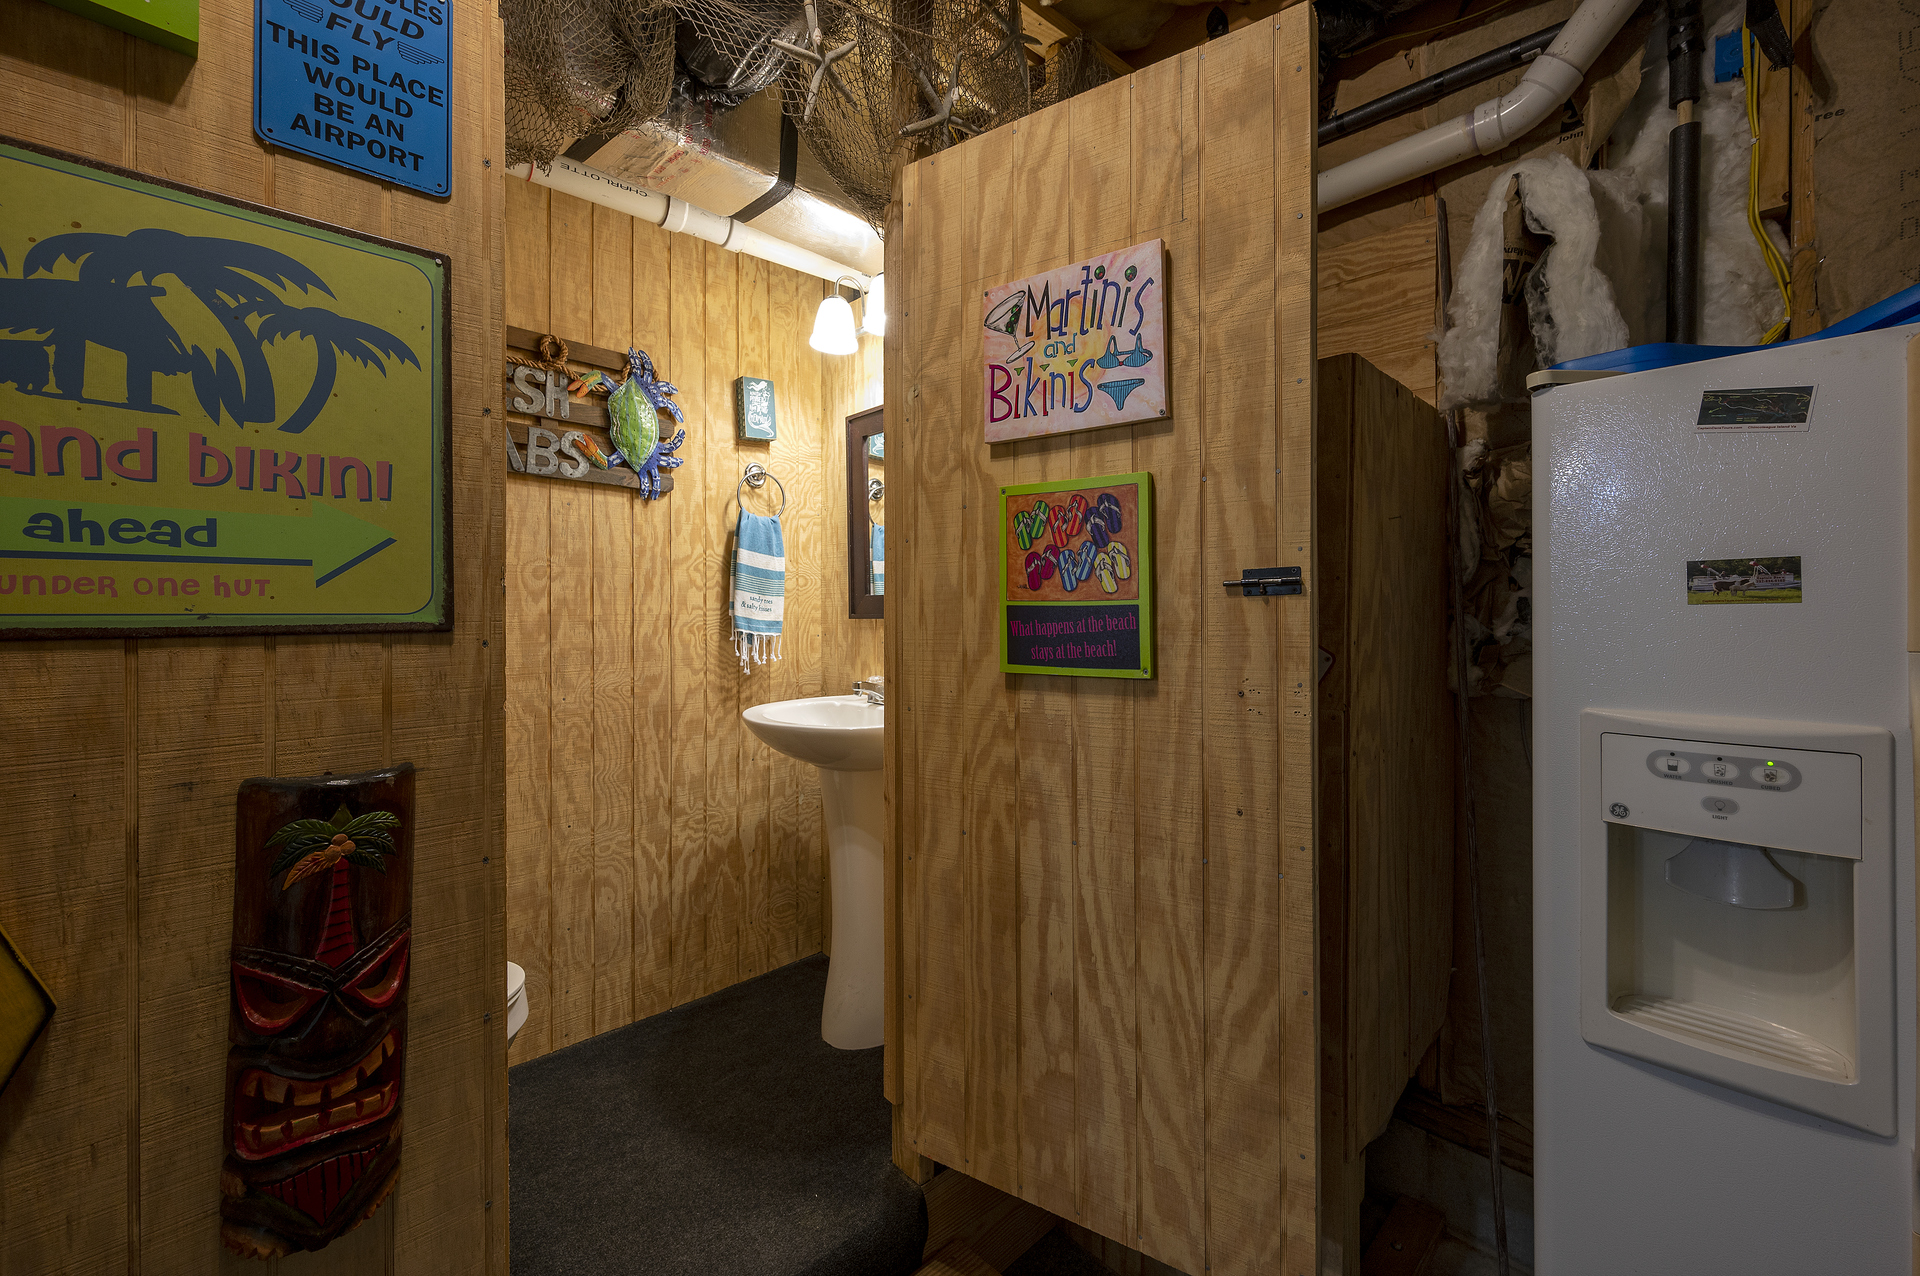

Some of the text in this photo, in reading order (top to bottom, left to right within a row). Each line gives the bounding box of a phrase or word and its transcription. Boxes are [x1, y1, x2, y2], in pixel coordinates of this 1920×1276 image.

[326, 12, 395, 51] FLY
[266, 19, 444, 107] THIS PLACE
[303, 61, 413, 118] WOULD
[314, 93, 404, 142] BE AN
[290, 112, 424, 172] AIRPORT
[559, 161, 648, 198] CHARLOTTE
[1025, 264, 1154, 340] Martinis
[1043, 332, 1077, 358] and
[506, 363, 570, 419] SH
[989, 356, 1095, 423] Bikinis
[22, 508, 217, 548] ahead
[133, 576, 200, 597] one
[746, 602, 758, 611] salty
[1010, 612, 1136, 638] What happens at the beach
[1031, 639, 1117, 662] stays at the beach!
[1707, 778, 1733, 786] CRUSHED
